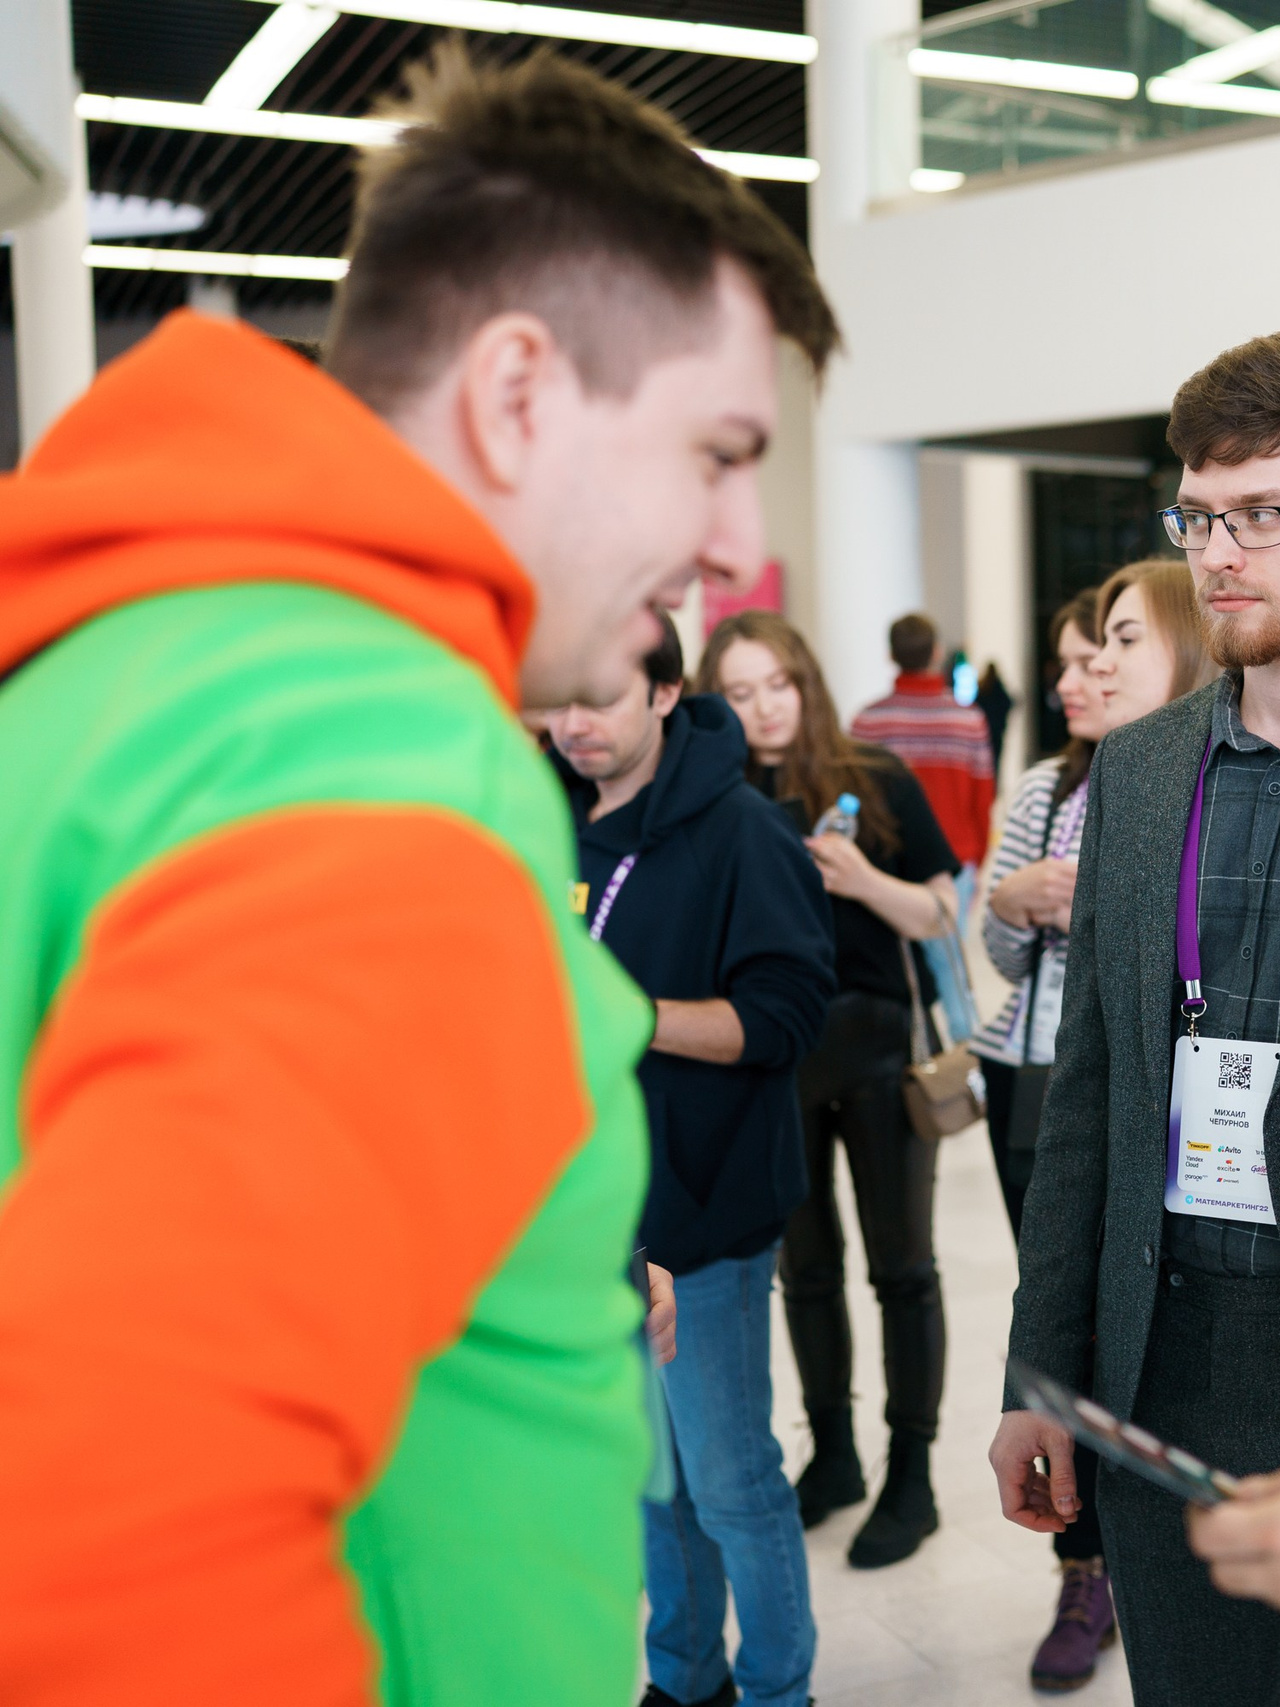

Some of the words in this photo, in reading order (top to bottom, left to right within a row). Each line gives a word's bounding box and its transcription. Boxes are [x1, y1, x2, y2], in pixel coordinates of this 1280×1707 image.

[1214, 1108, 1246, 1118] МИХАИЛ
[1209, 1117, 1250, 1128] ЧЕПУРНОВ
[1224, 1146, 1242, 1154] Avito
[1217, 1165, 1236, 1173] excite
[1195, 1197, 1269, 1211] МАТЕМАРКЕТИНГ22
